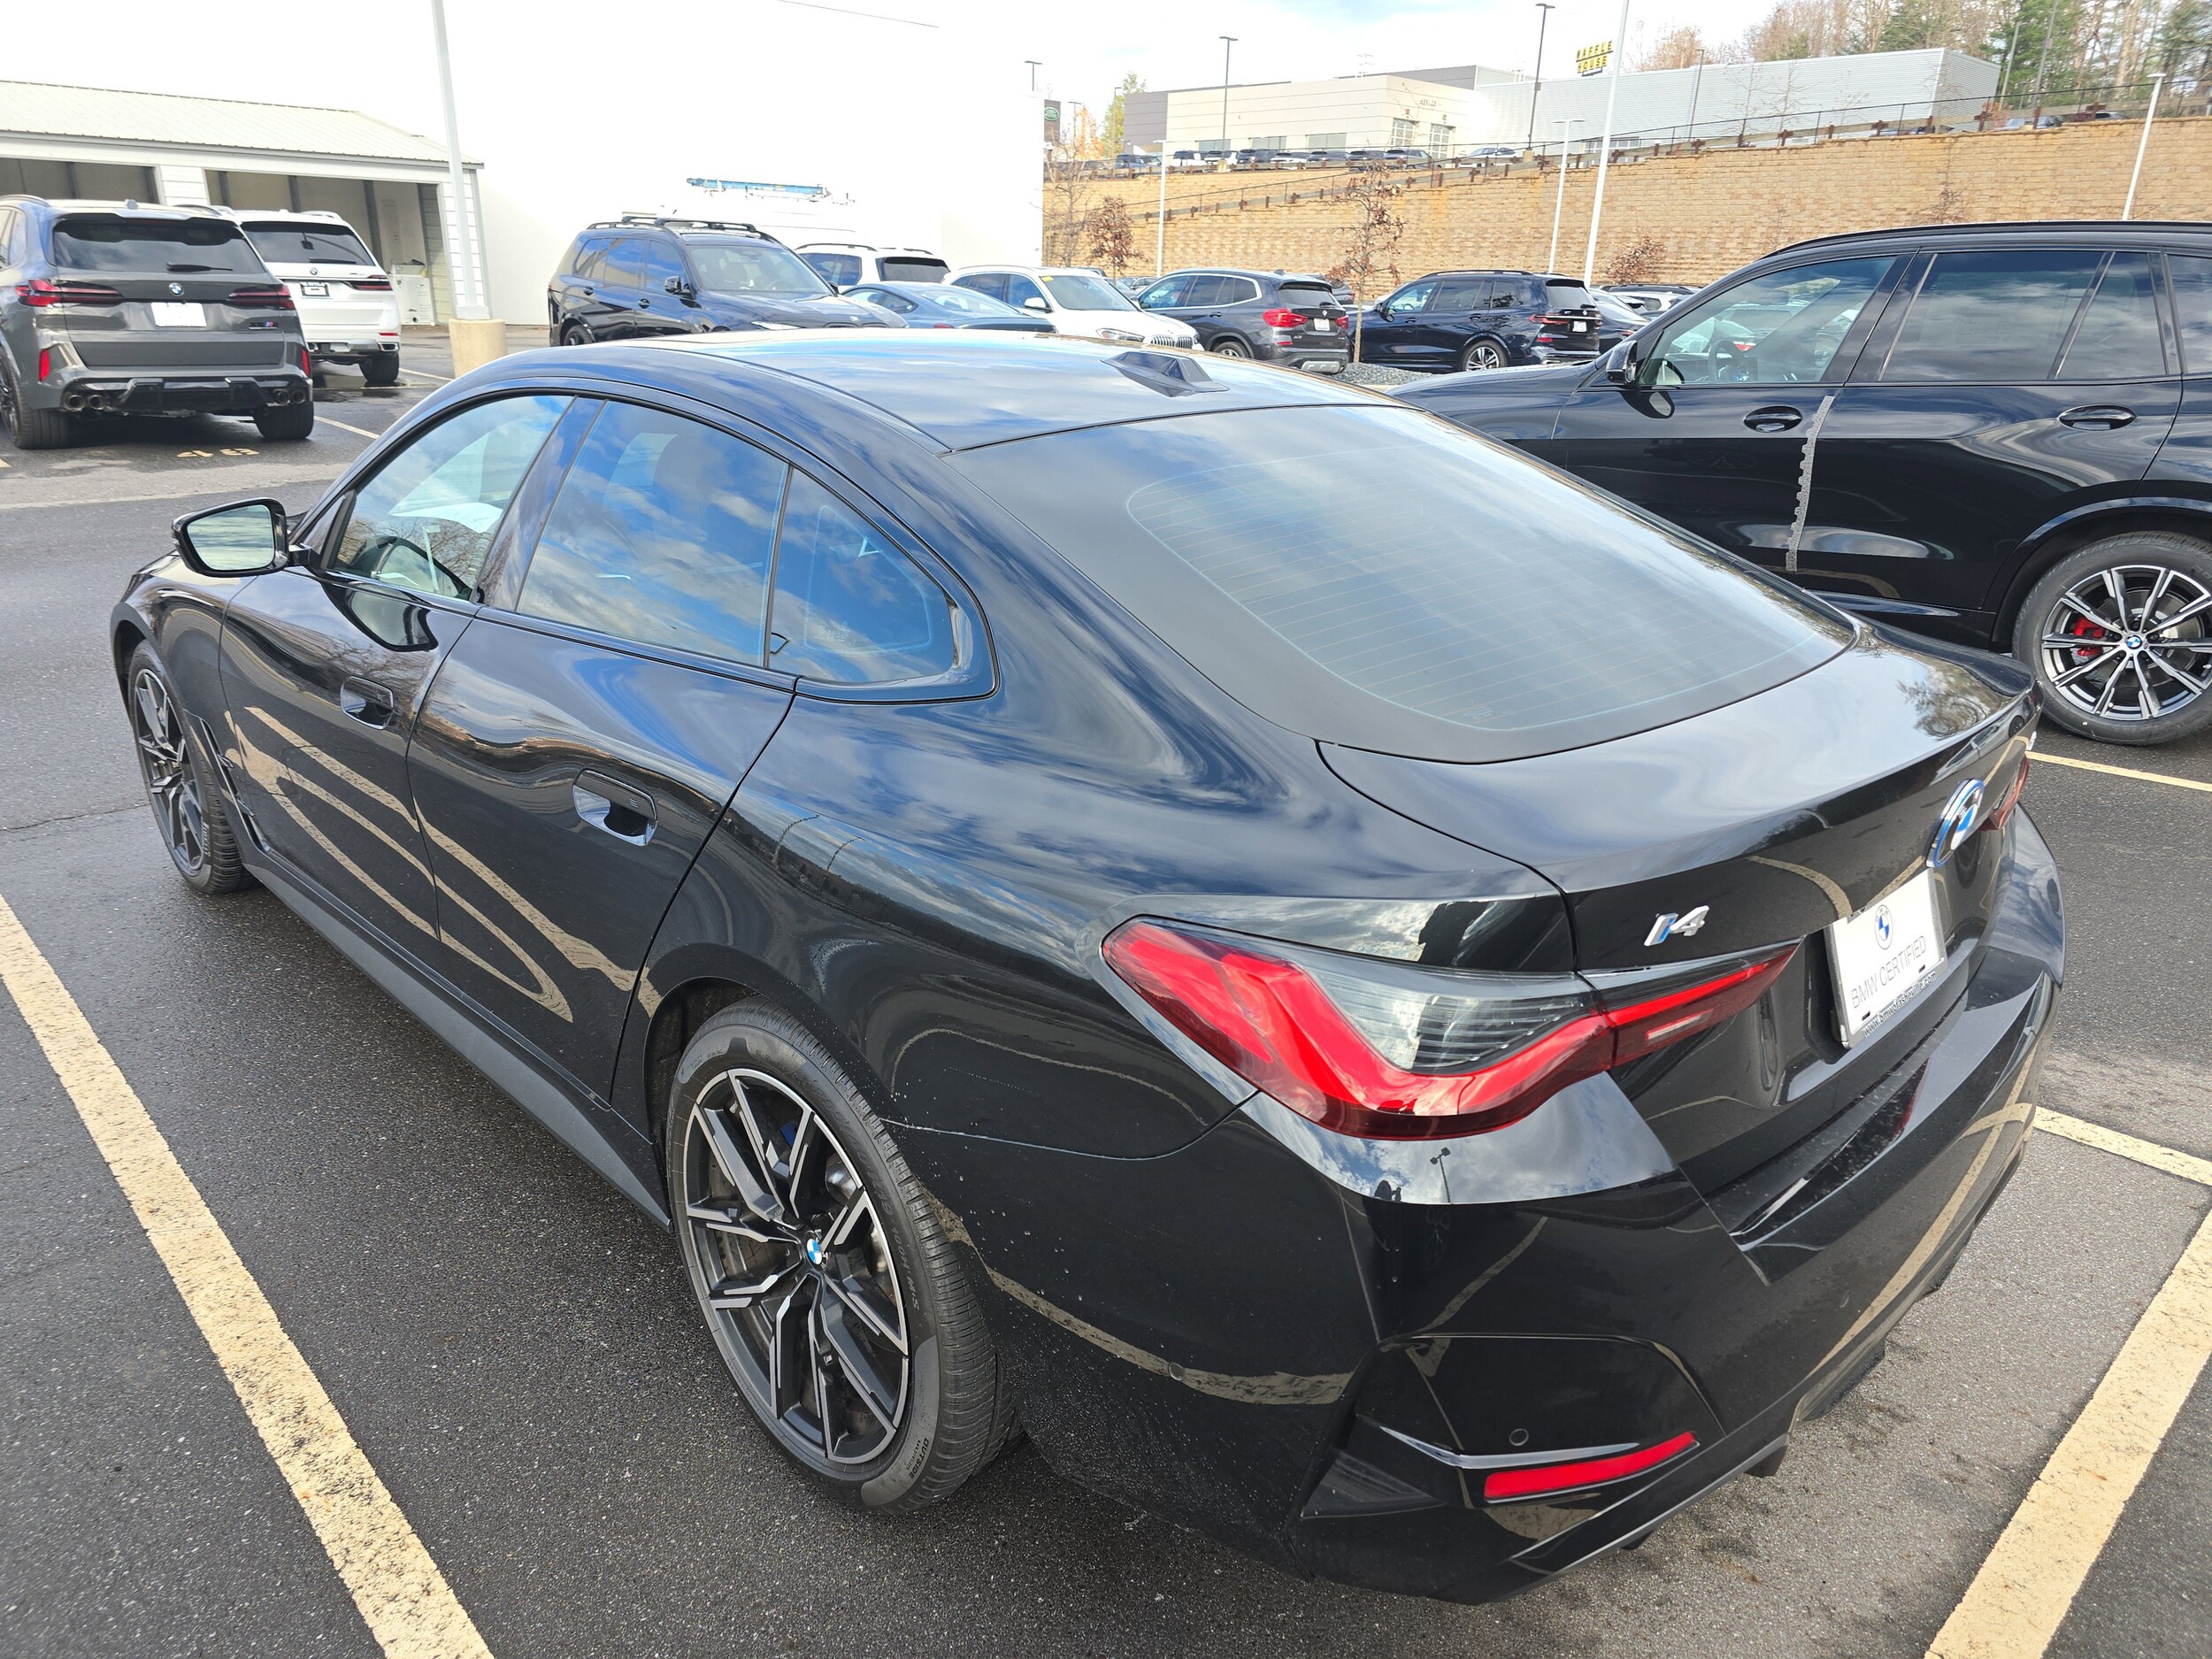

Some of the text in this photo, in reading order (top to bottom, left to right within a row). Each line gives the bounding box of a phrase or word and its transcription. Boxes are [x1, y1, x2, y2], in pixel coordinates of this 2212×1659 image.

[1576, 40, 1613, 59] WAFFLE
[1577, 55, 1608, 72] HOUSE
[1851, 935, 1926, 1009] BMW CERTIFIED
[1862, 972, 1937, 1037] www.bmwofasheville.com
[908, 1437, 930, 1479] OUTSIDE
